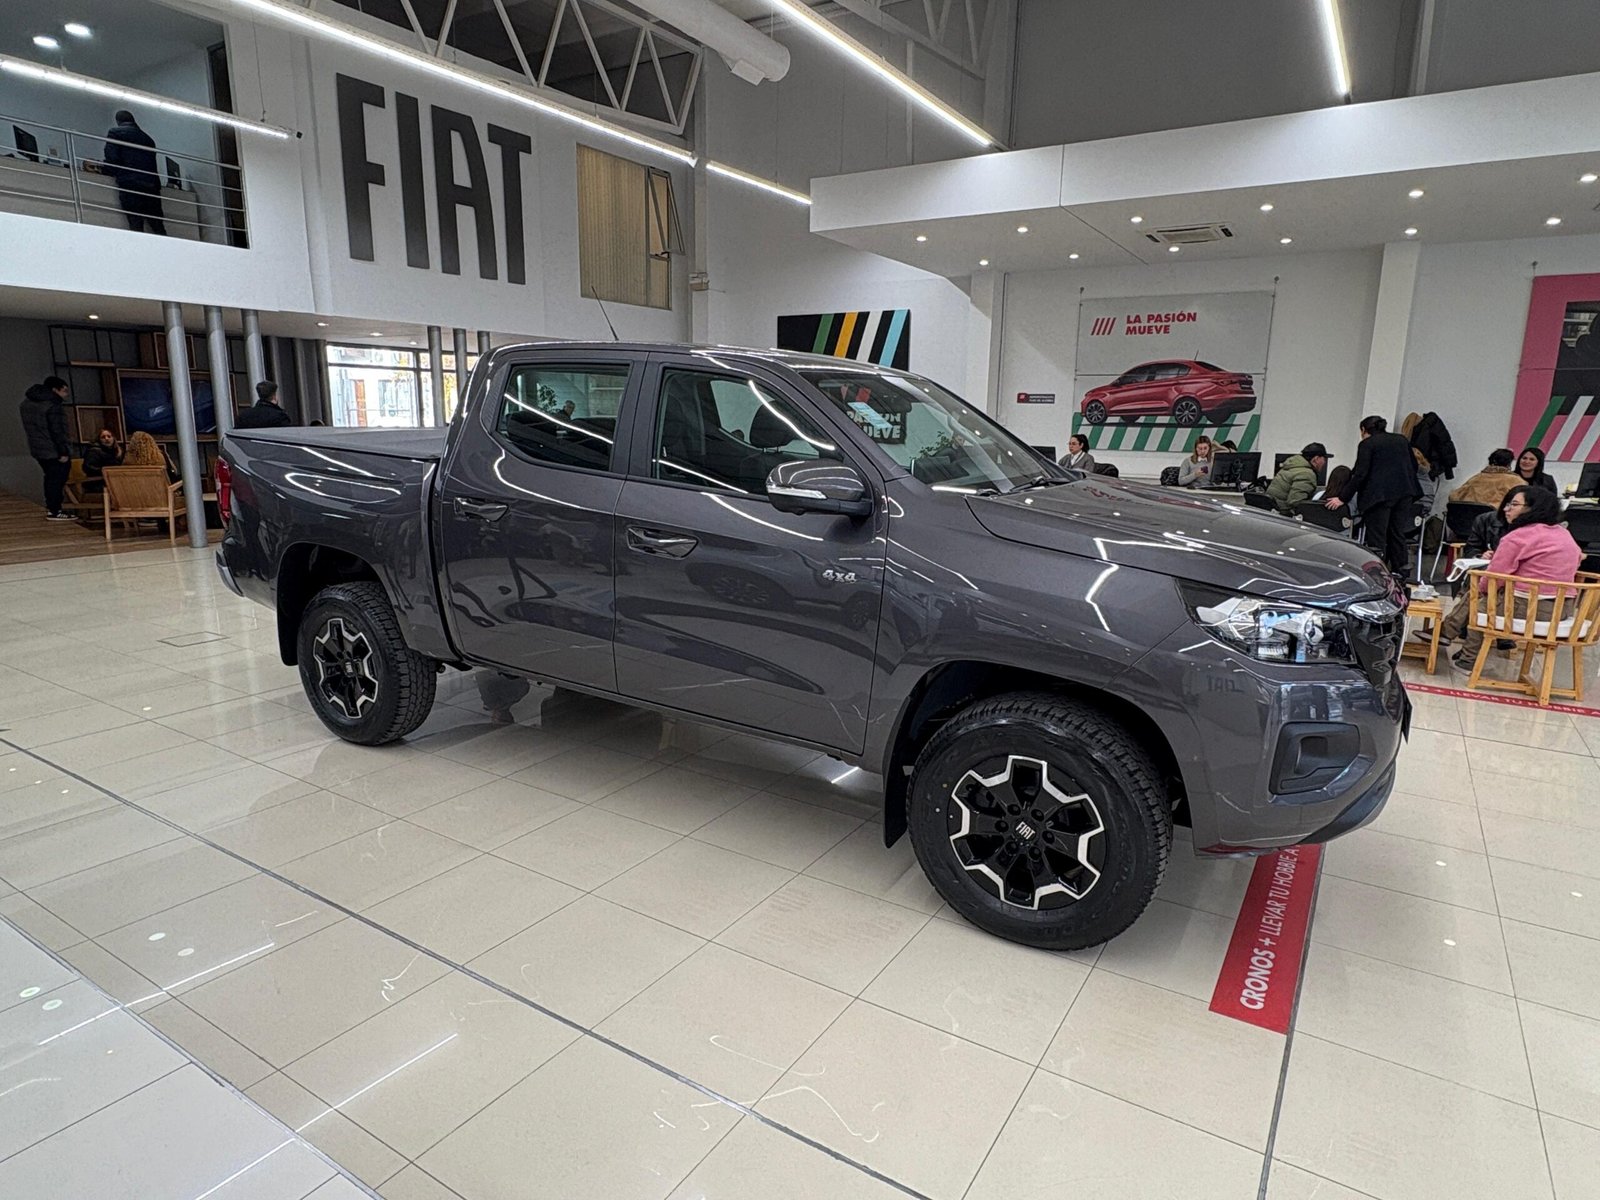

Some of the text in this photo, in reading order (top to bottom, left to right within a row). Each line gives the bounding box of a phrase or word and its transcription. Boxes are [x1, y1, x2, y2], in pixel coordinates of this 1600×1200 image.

[336, 72, 532, 285] FIAT
[1126, 311, 1197, 324] LA PASIÓN
[1125, 325, 1171, 335] MUEVE
[847, 411, 901, 423] PAN
[862, 425, 901, 439] UEVE
[1527, 701, 1585, 713] HBBIE
[1015, 821, 1036, 840] FIAT
[1272, 855, 1298, 888] HOBBIE
[1268, 886, 1290, 901] TU
[1259, 900, 1287, 937] LLEVAR
[1239, 948, 1276, 1010] CRONOS
